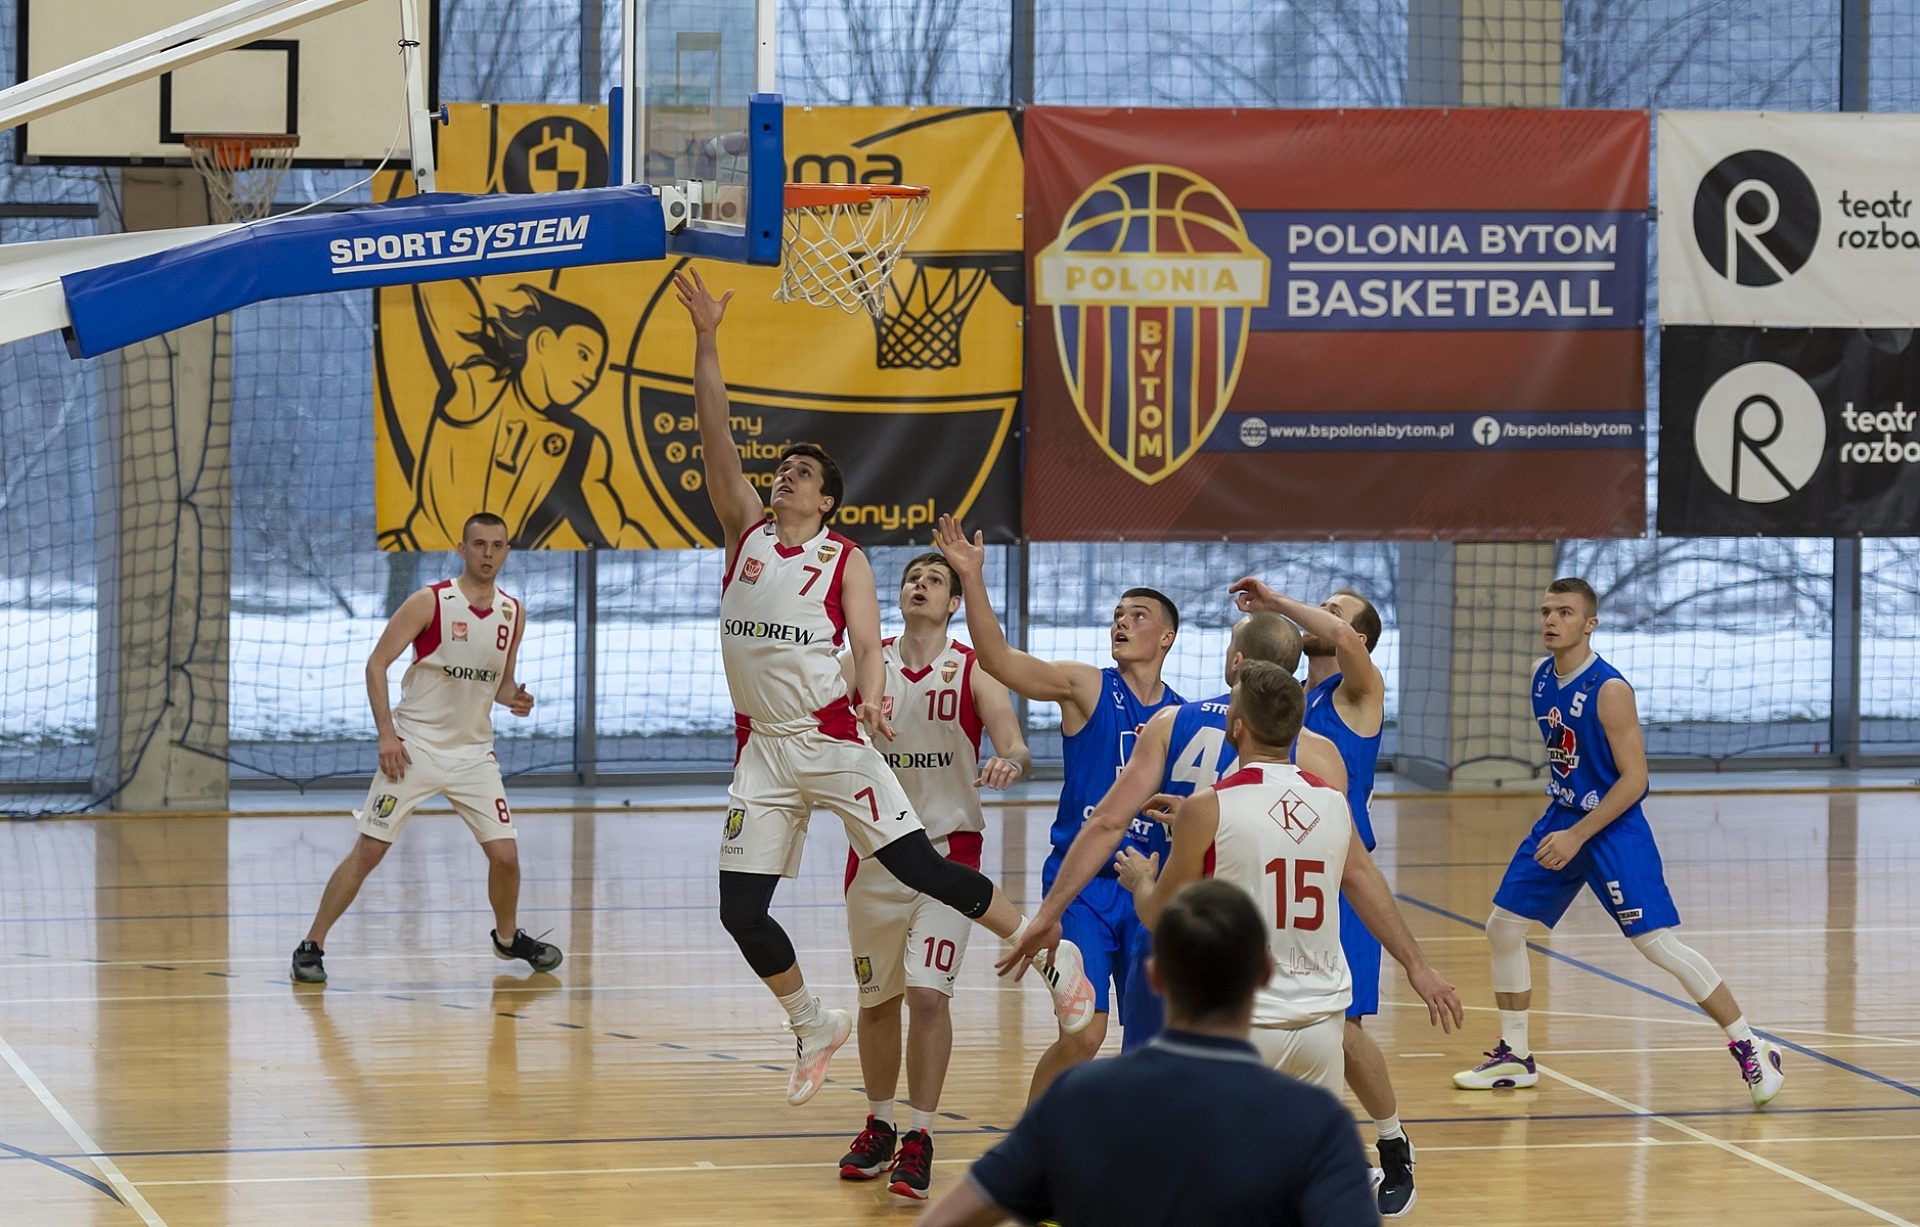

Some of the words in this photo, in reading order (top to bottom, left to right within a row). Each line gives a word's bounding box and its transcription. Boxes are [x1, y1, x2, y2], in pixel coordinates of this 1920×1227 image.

[783, 154, 903, 185] ma
[1838, 190, 1912, 218] teatr
[330, 230, 446, 264] SPORT
[449, 214, 590, 260] SYSTEM
[1288, 224, 1467, 255] POLONIA
[1481, 224, 1618, 255] BYTOM
[1065, 266, 1239, 293] POLONIA
[1286, 280, 1615, 318] BASKETBALL
[1138, 318, 1163, 459] BYTOM
[1269, 424, 1455, 441] www.bspoloniabytom.pl
[1503, 422, 1633, 440] /bspoloniabytom
[1840, 402, 1917, 433] teatr
[799, 565, 822, 596] 7
[496, 624, 509, 651] 8
[725, 618, 814, 646] SORDREW
[926, 689, 957, 721] 10
[1569, 691, 1588, 718] 5
[496, 798, 510, 823] 8
[854, 786, 879, 822] 7
[1280, 800, 1308, 831] K
[1265, 858, 1325, 931] 15
[1606, 880, 1625, 905] 5
[924, 936, 955, 972] 10
